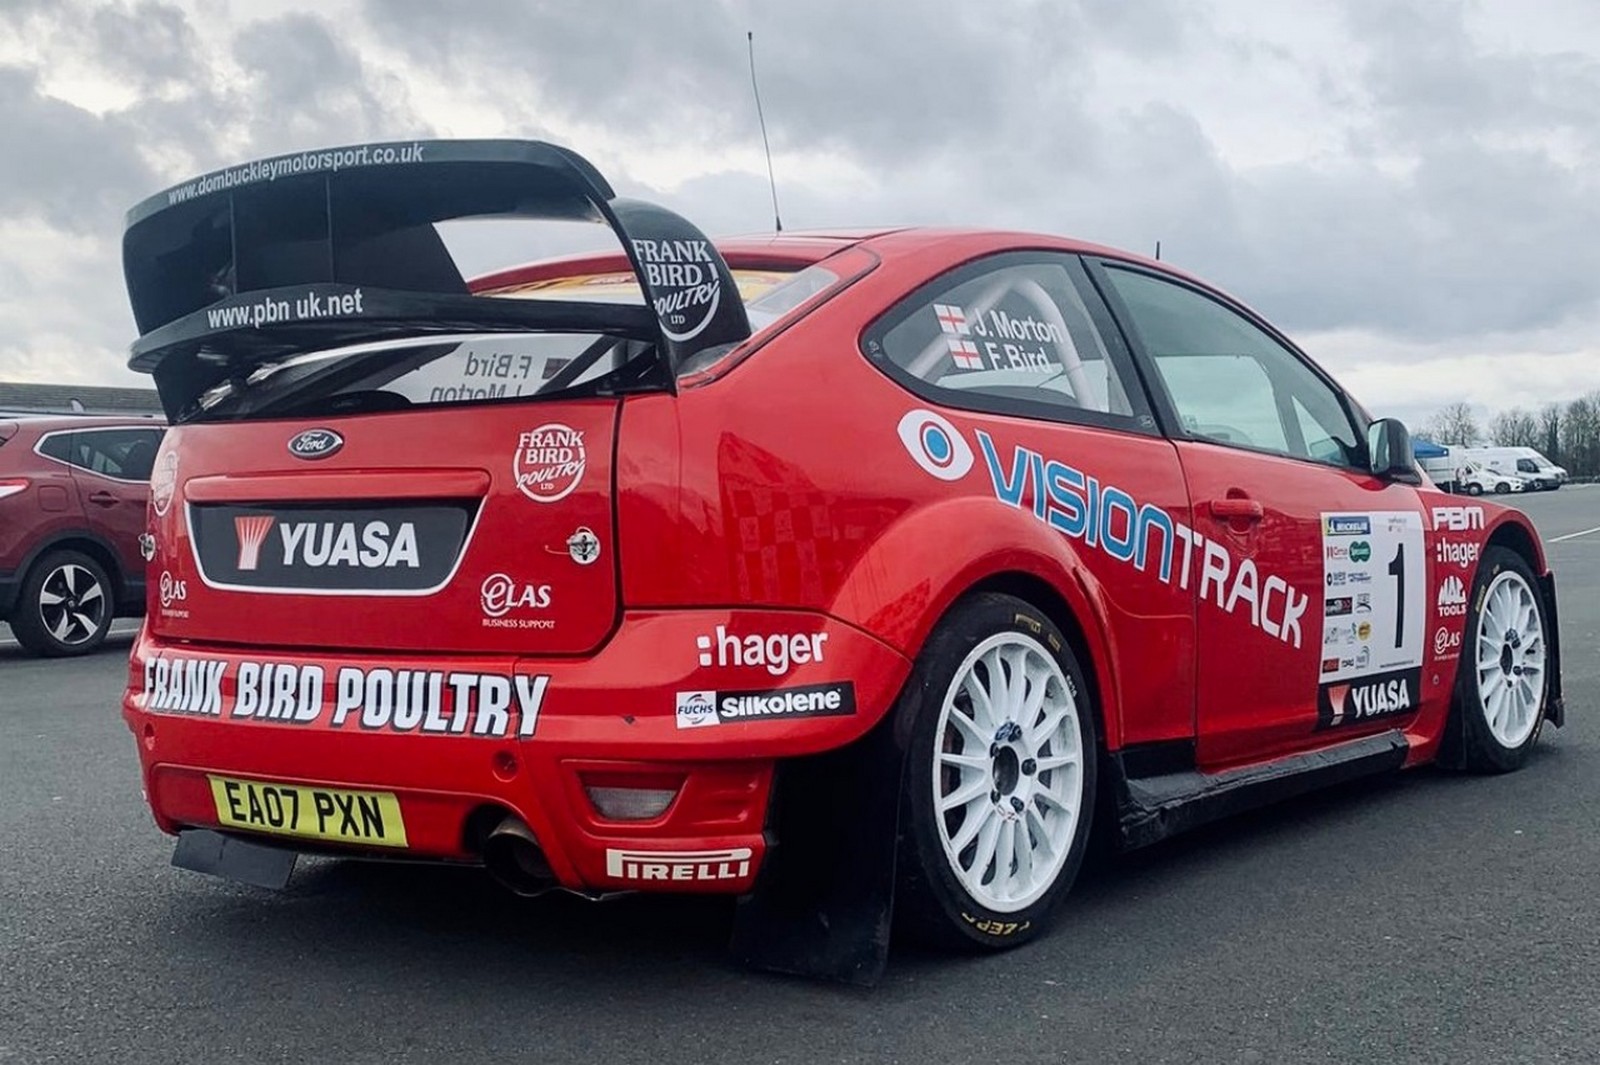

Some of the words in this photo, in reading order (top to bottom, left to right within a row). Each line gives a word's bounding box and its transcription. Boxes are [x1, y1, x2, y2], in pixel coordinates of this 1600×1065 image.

[168, 142, 424, 205] www.dombuckleymotorsport.co.uk
[632, 240, 712, 262] FRANK
[646, 263, 703, 286] BIRD
[653, 281, 719, 316] OULTRY
[990, 309, 1065, 345] Morton
[519, 431, 584, 448] FRANK
[525, 447, 573, 464] BIRD
[516, 458, 586, 489] POULTRY
[1432, 506, 1485, 532] PBM
[279, 521, 420, 569] YUASA
[1388, 542, 1405, 649] 1
[1438, 603, 1467, 618] TOOLS
[482, 618, 518, 628] BUSINESS
[518, 618, 556, 630] SUPPORT
[140, 656, 228, 716] FRANK
[232, 660, 324, 724] BIRD
[333, 666, 551, 737] POULTRY
[677, 704, 714, 716] FUCHS
[720, 689, 842, 719] Silkolene
[1351, 678, 1411, 719] YUASA
[224, 781, 300, 831] EA07
[312, 791, 386, 839] PXN
[605, 847, 753, 881] PIRELLI
